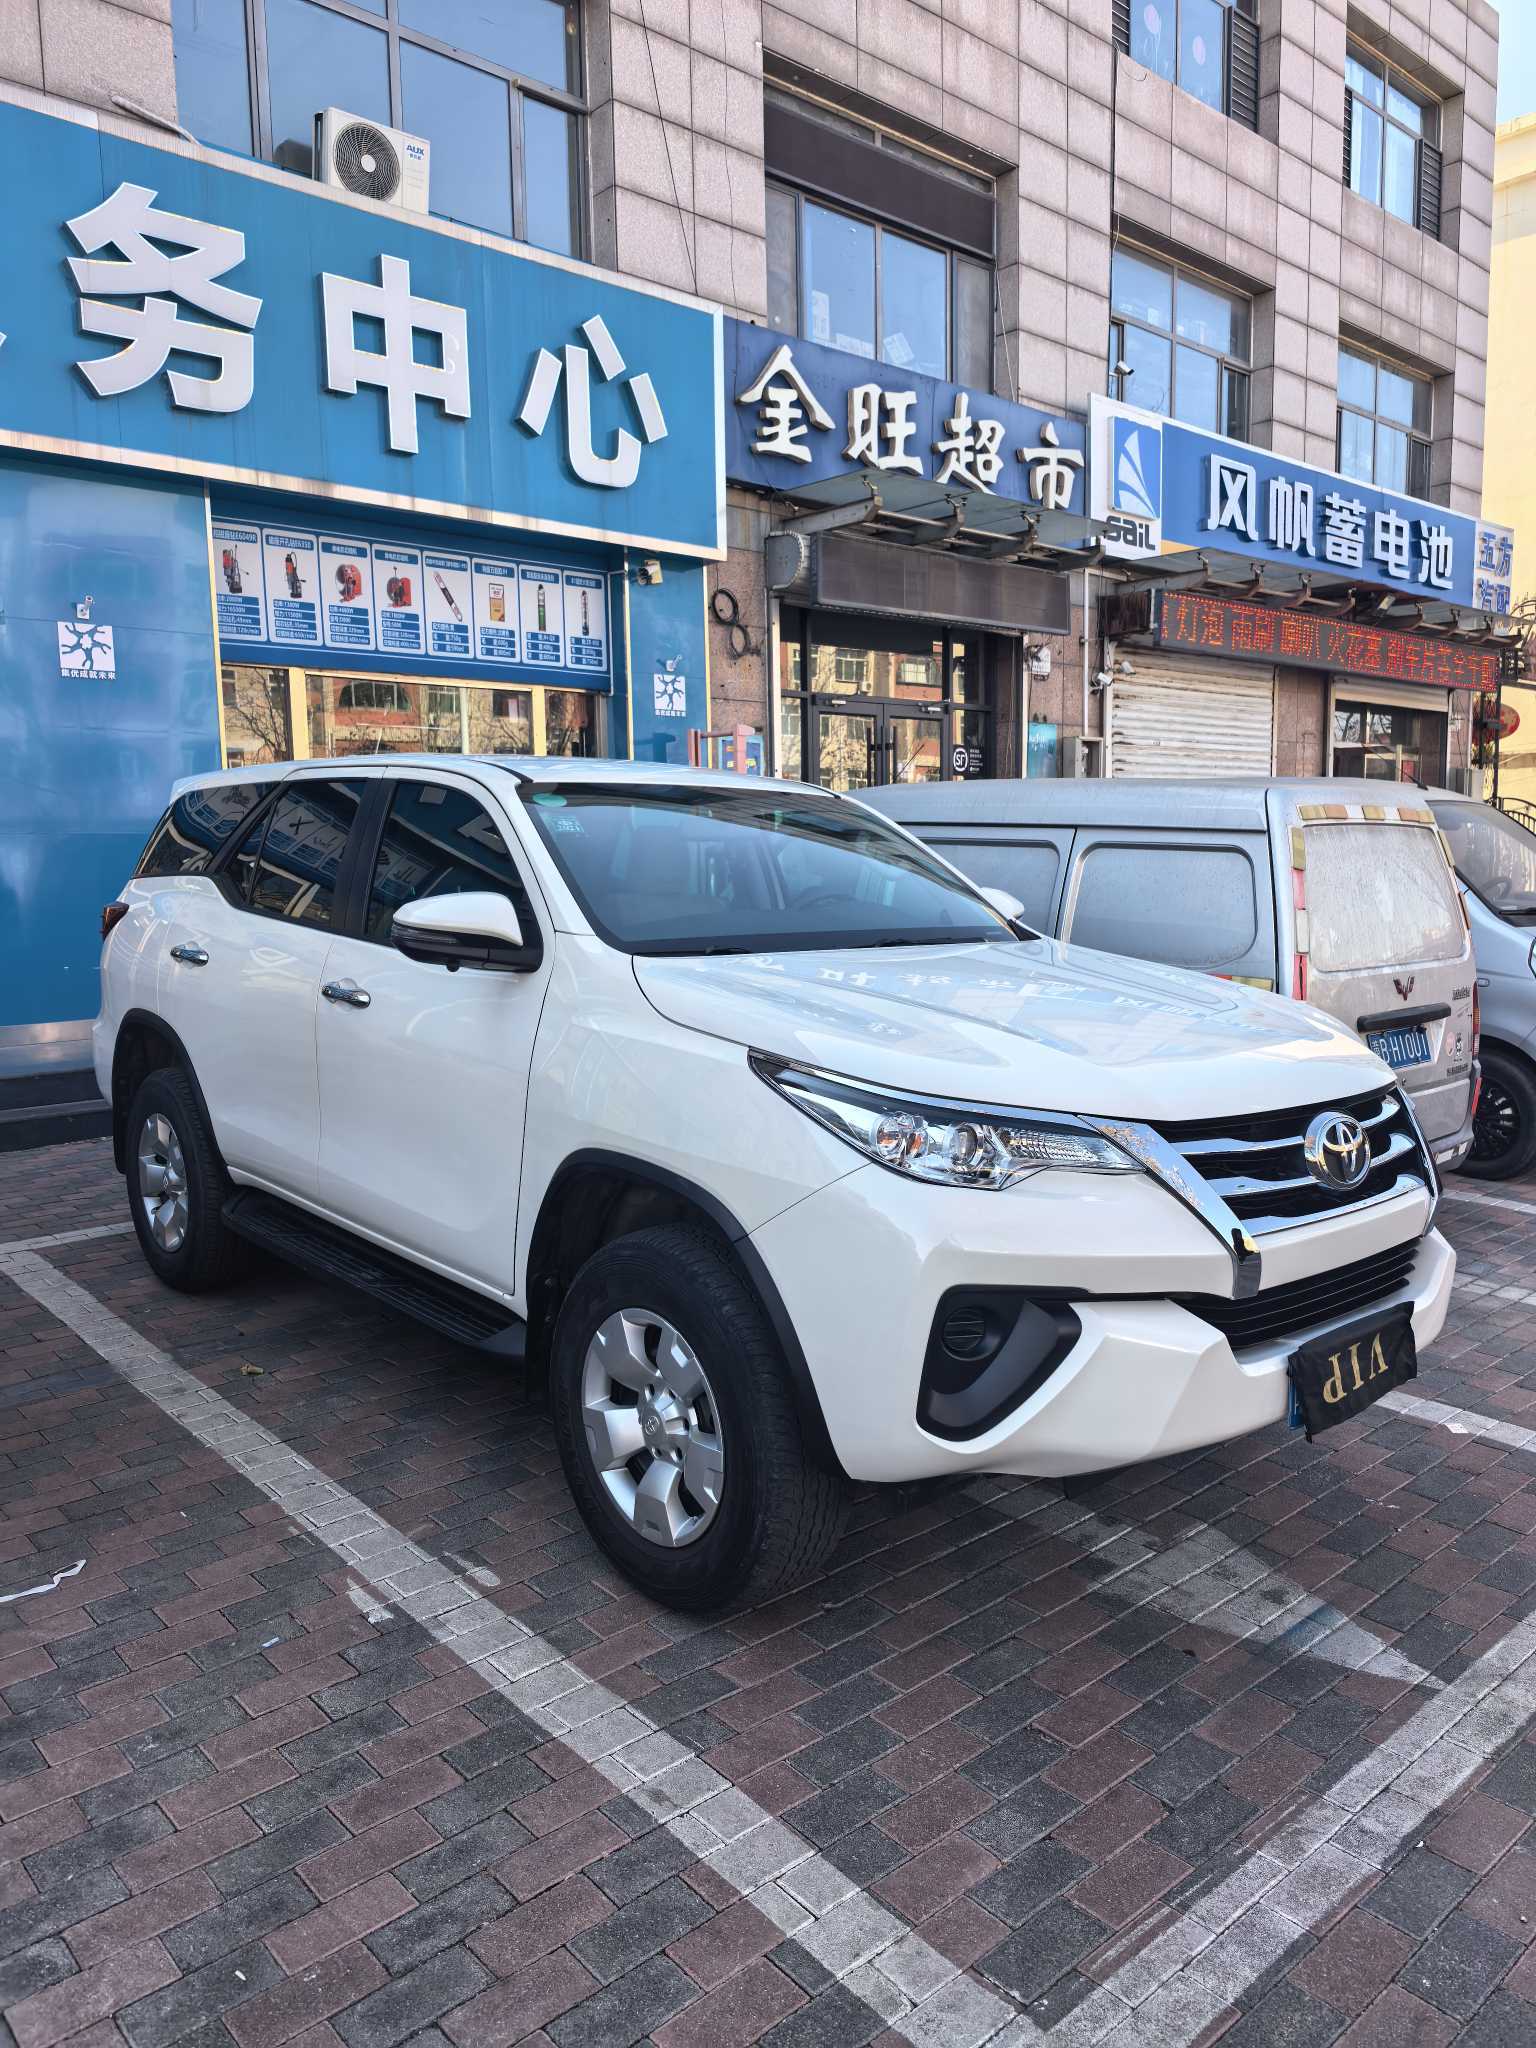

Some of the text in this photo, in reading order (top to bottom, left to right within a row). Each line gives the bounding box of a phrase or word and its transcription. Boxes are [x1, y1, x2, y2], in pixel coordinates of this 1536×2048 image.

[406, 145, 425, 156] AUX
[0, 182, 668, 488] 务中心
[736, 346, 1084, 510] 金旺超市
[1208, 453, 1453, 590] 风帆蓄电池
[1176, 598, 1224, 645] 灯泡
[1323, 1333, 1388, 1403] VIP
